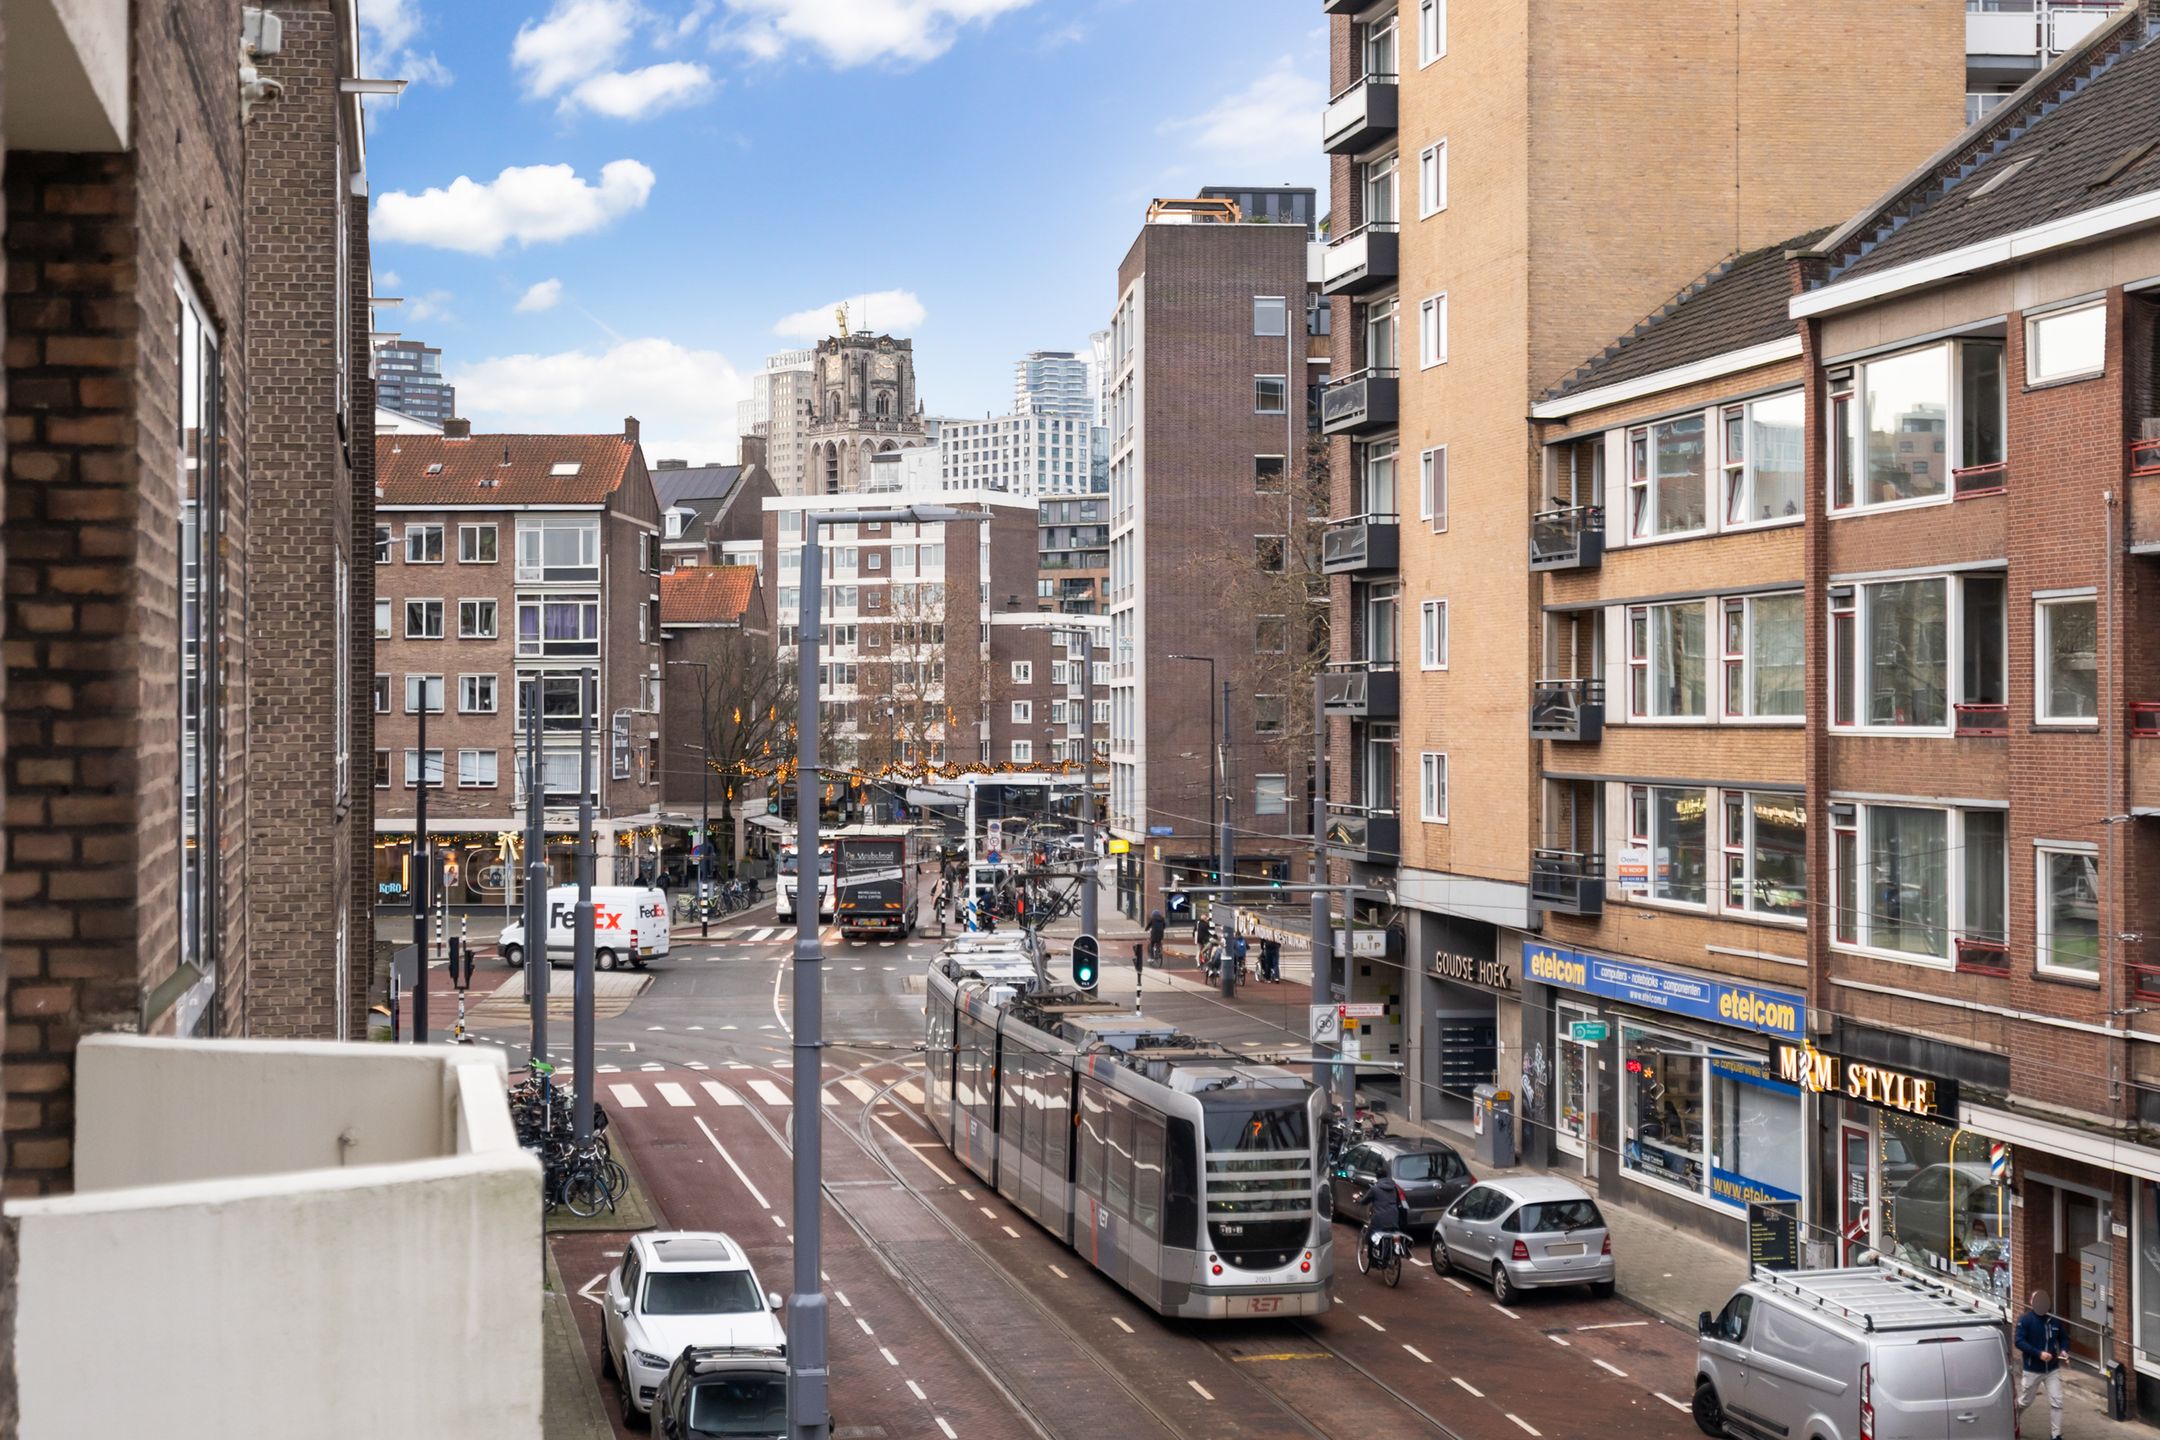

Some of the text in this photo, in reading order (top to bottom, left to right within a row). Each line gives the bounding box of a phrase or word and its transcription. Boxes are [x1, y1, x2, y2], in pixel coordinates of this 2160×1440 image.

[550, 902, 623, 930] FeEx
[640, 903, 665, 918] FedEx
[1436, 951, 1507, 988] GOUDSE HOEK
[1531, 952, 1585, 985] etelcom
[1600, 967, 1701, 997] computers notebooks componenten
[1319, 1020, 1332, 1029] 30
[1719, 989, 1795, 1032] etelcom
[1848, 1063, 1928, 1116] STYLE
[1253, 1122, 1262, 1136] 7
[1247, 1296, 1284, 1313] RET
